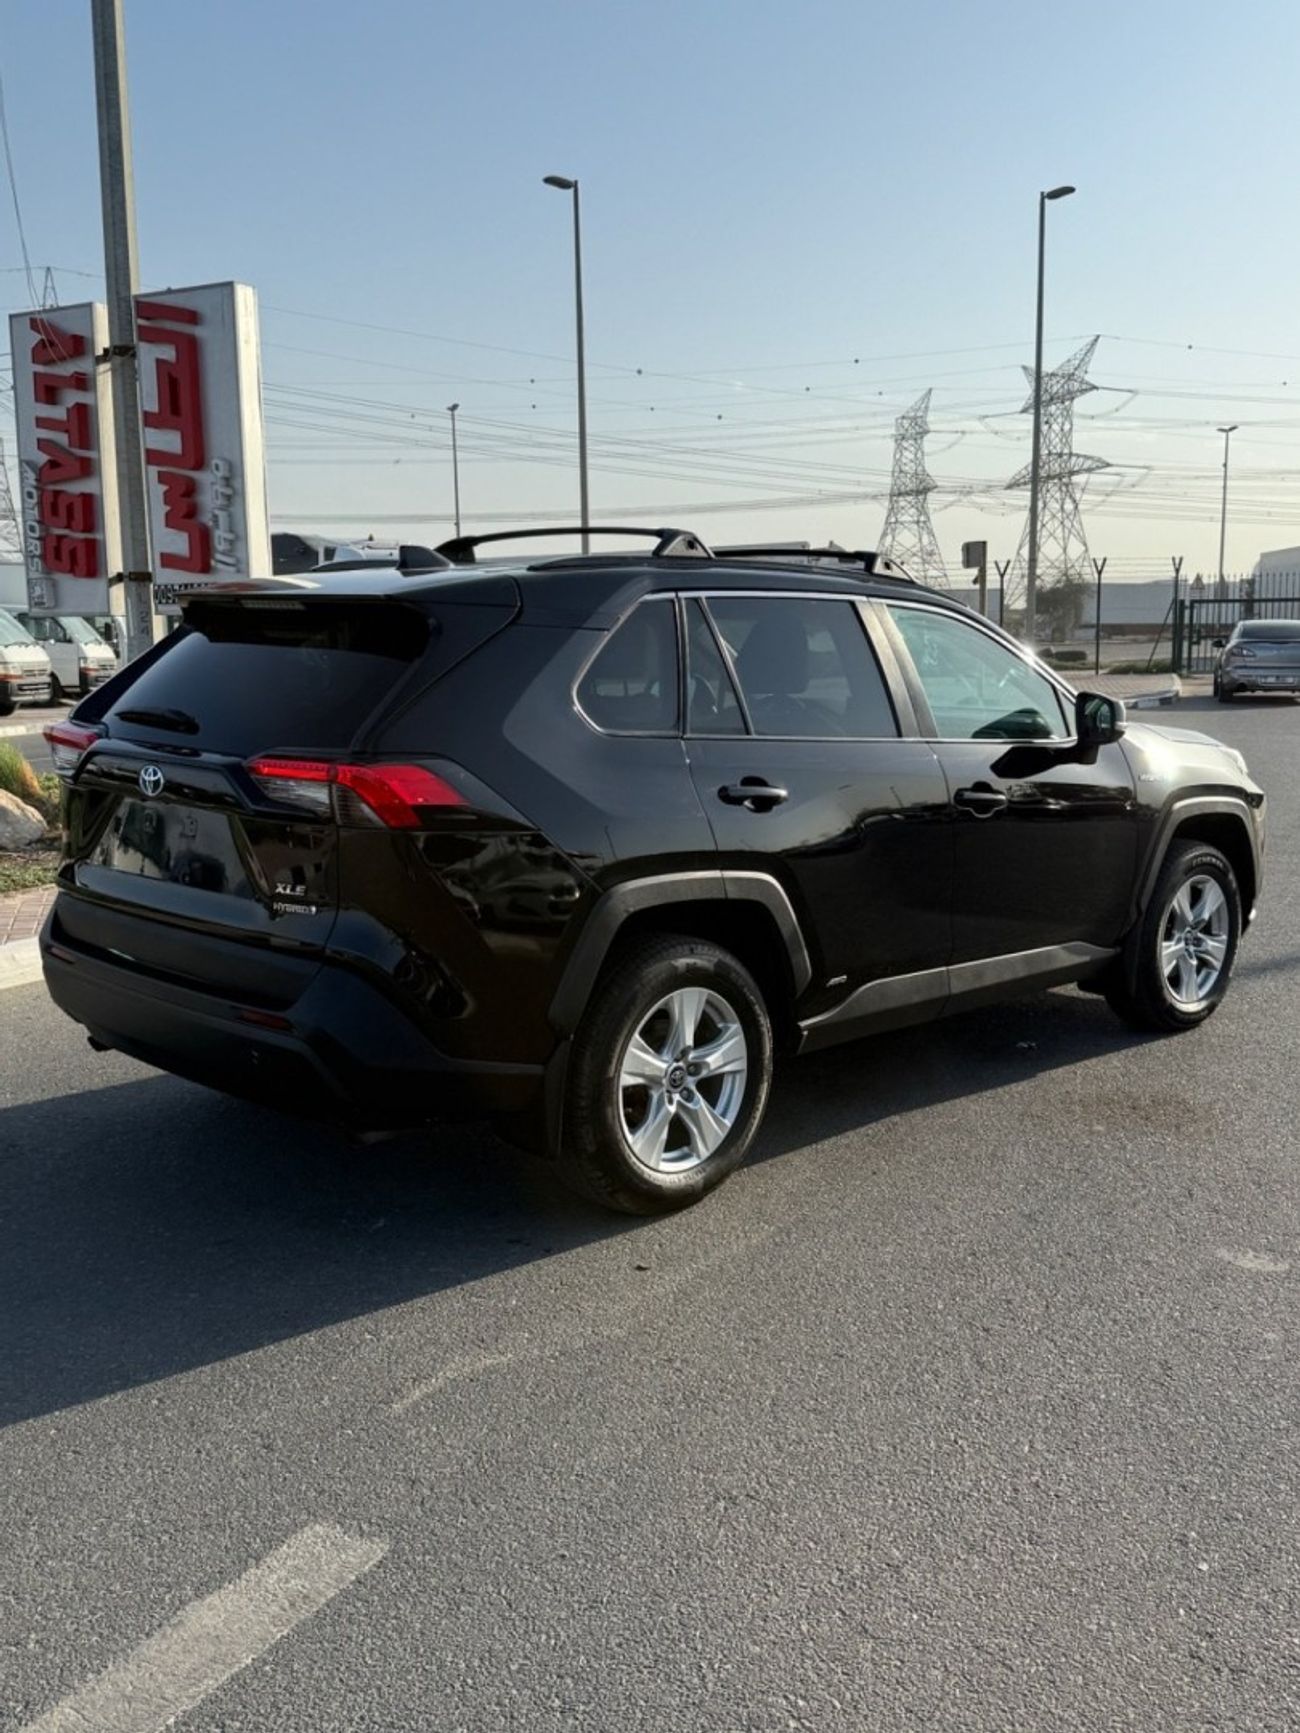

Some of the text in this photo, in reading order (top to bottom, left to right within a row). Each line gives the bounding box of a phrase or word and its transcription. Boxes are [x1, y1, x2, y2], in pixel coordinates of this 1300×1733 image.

[22, 463, 42, 573] MOTORS
[30, 317, 98, 578] ALTASS
[135, 300, 210, 574] الطاس
[275, 882, 307, 896] XLE
